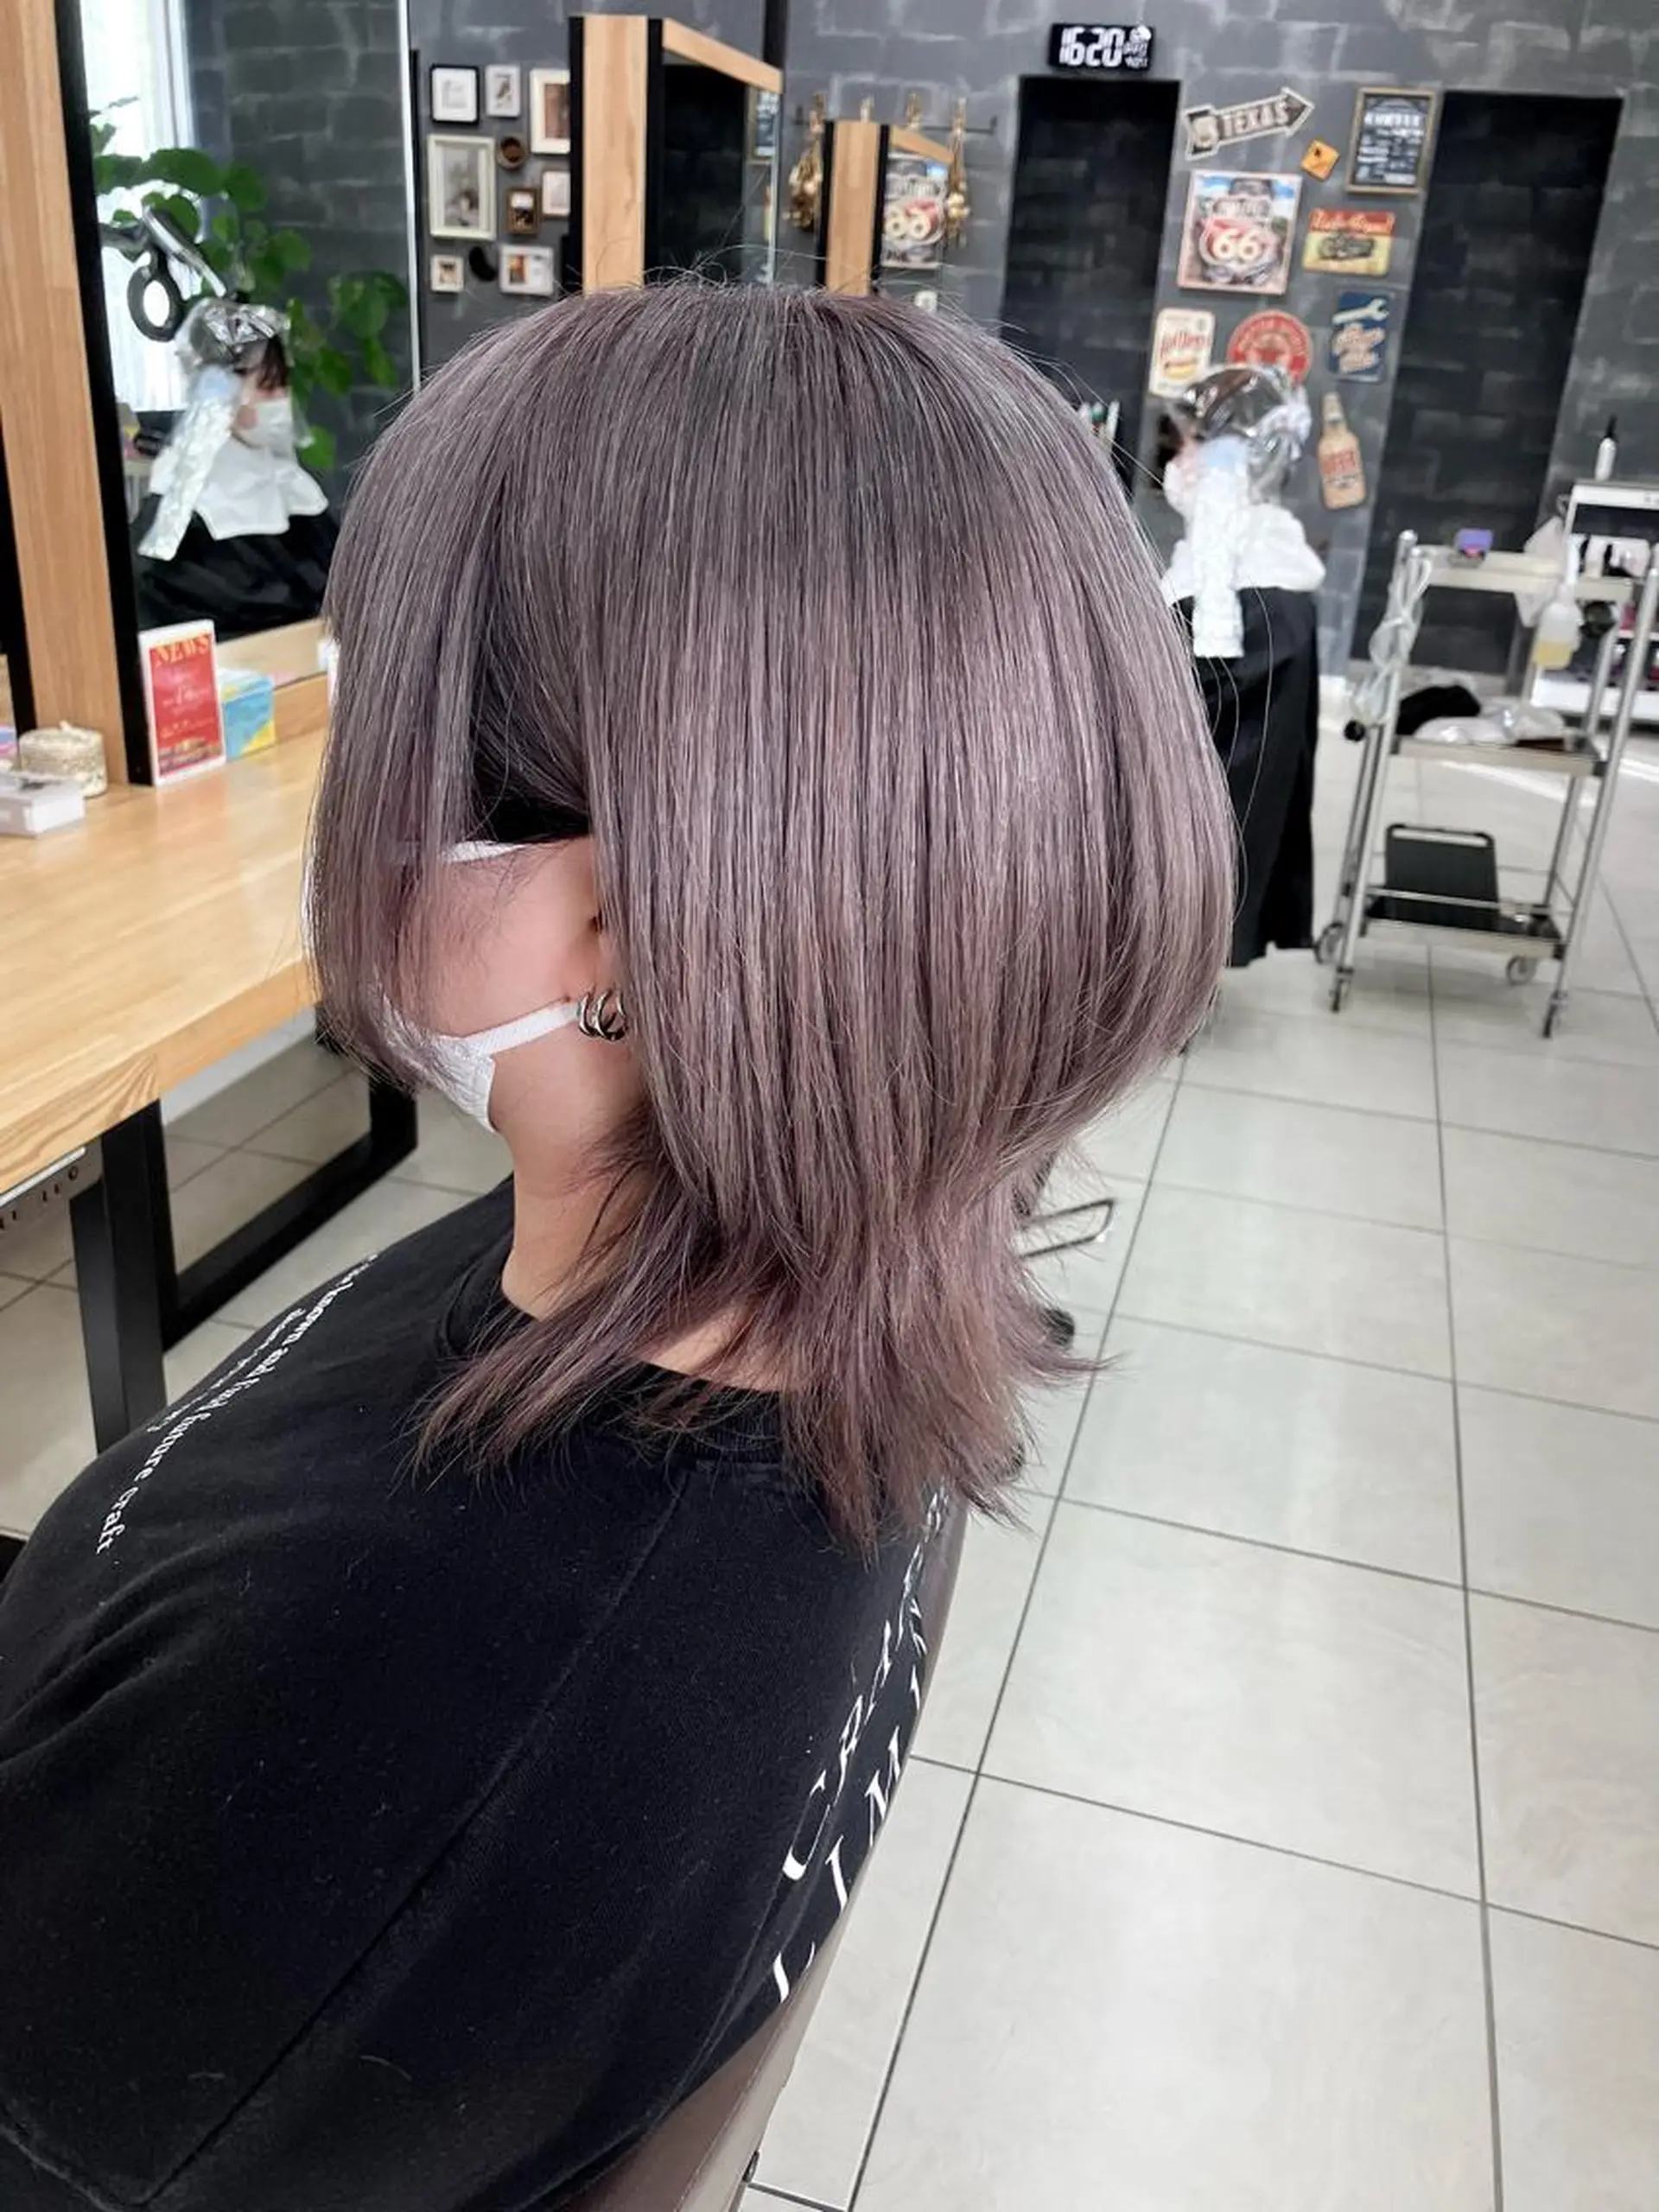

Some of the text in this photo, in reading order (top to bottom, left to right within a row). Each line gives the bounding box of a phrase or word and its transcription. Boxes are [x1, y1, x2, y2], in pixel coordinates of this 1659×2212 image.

[1211, 228, 1262, 261] 66
[133, 1412, 212, 1482] future
[96, 1486, 139, 1554] craft
